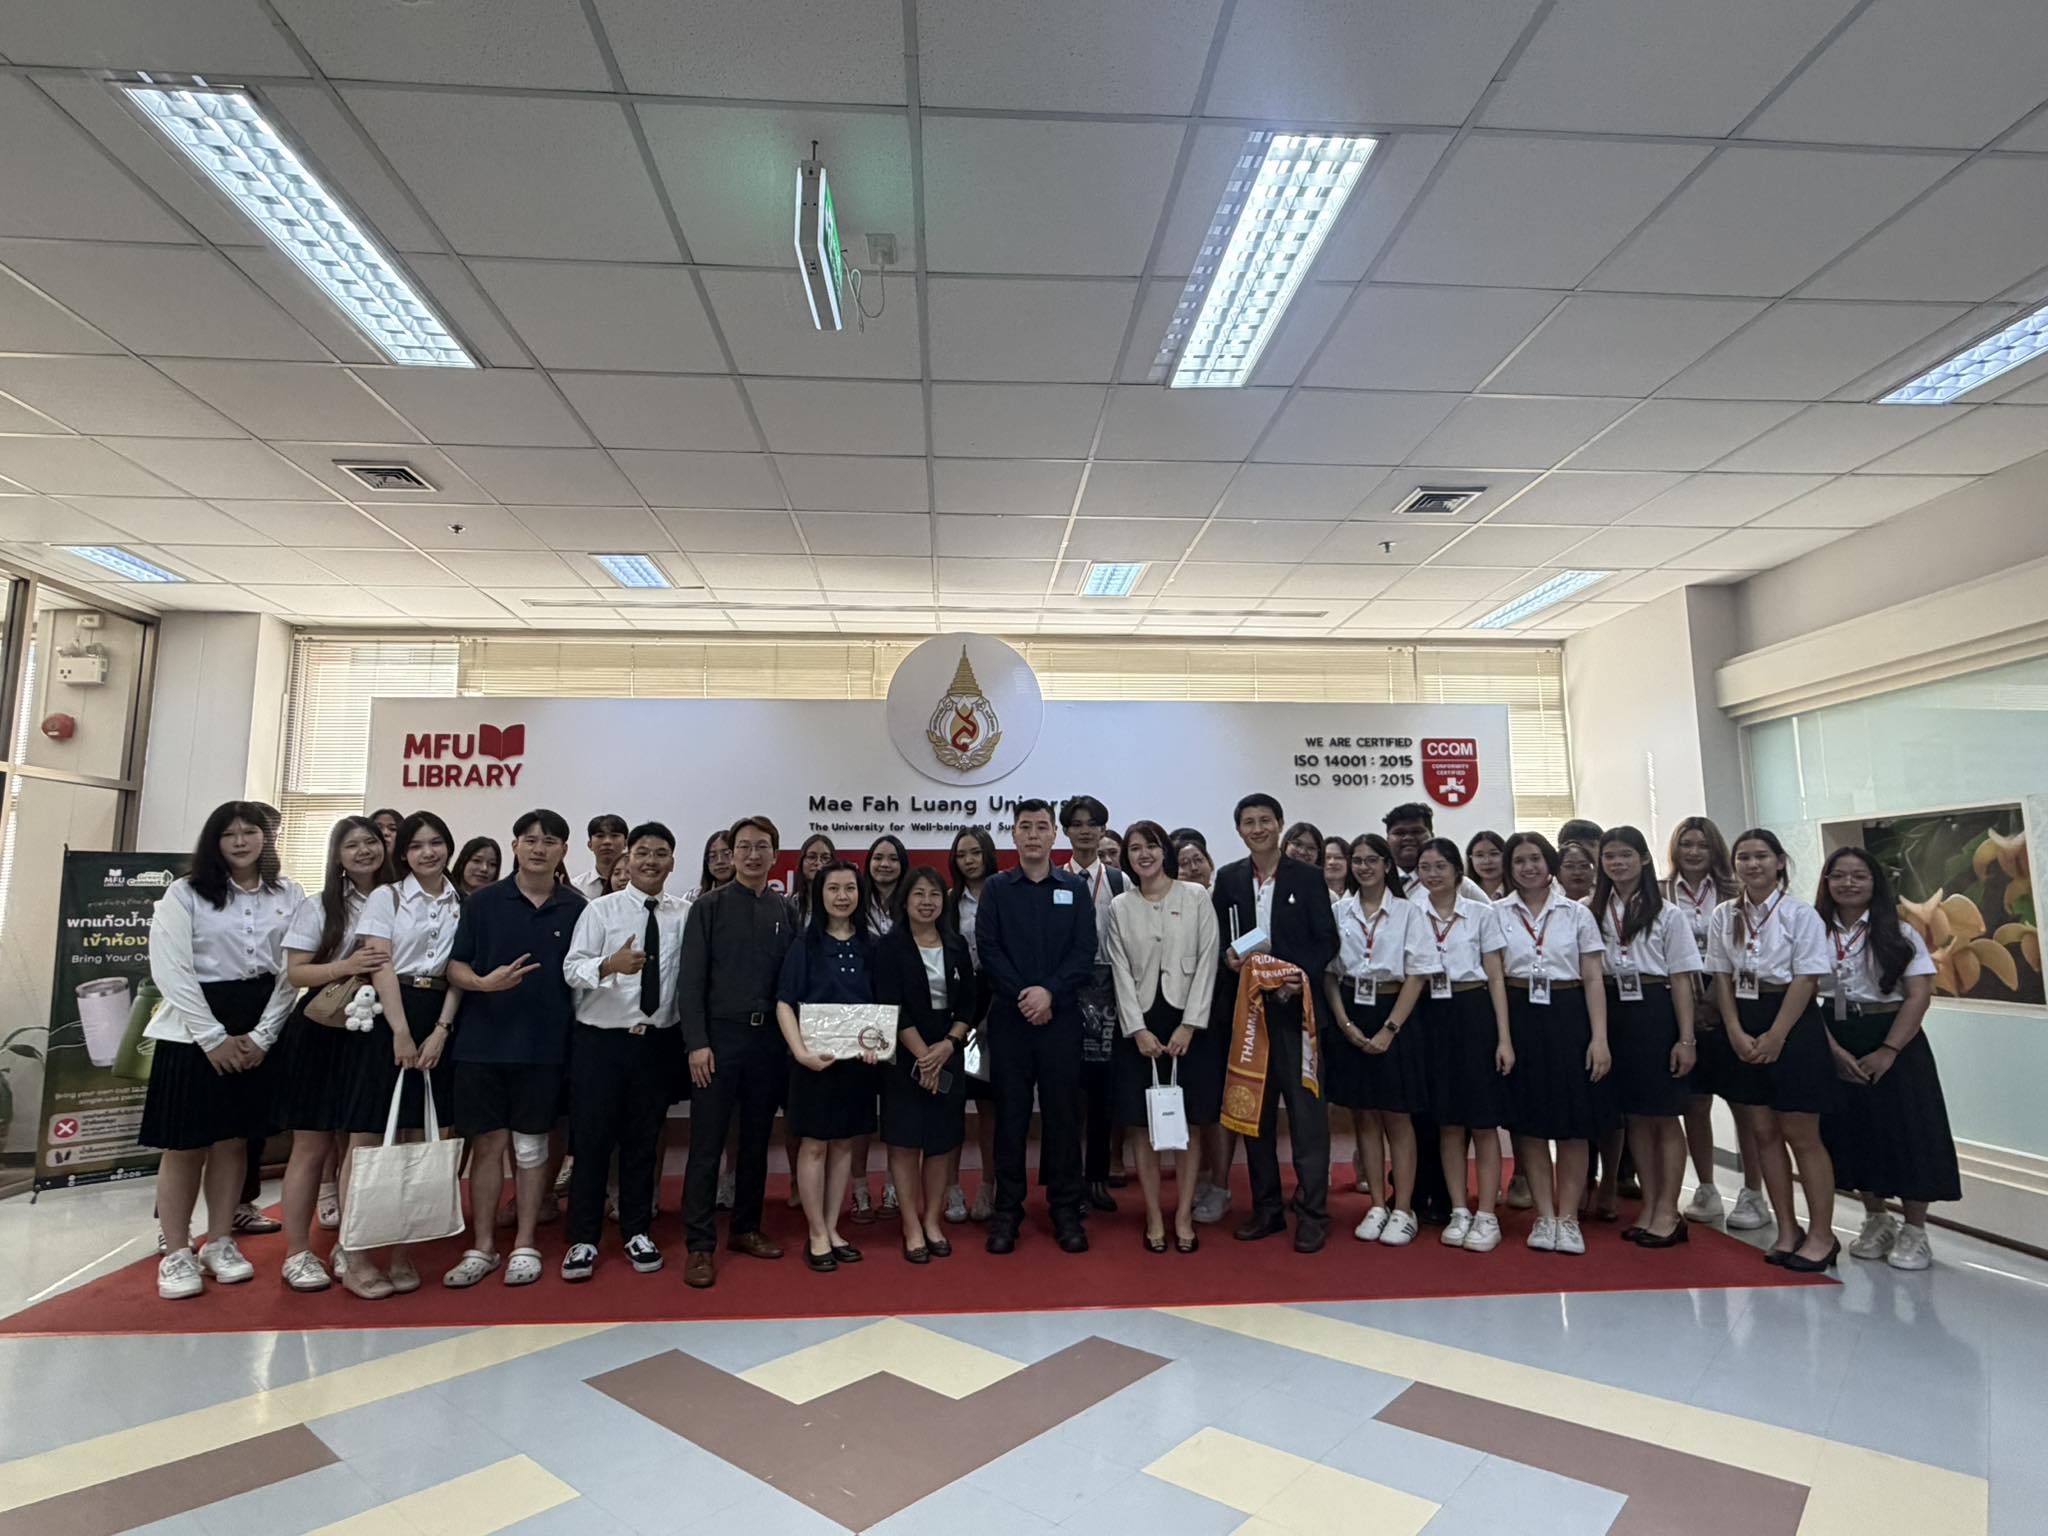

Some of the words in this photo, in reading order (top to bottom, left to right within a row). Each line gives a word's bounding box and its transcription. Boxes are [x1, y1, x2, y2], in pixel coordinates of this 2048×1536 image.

[403, 733, 475, 759] MFU
[1305, 737, 1324, 747] WE
[1329, 737, 1351, 747] ARE
[1356, 737, 1413, 747] CERTIFIED
[1427, 742, 1473, 756] CCQM
[1294, 755, 1319, 767] ISO
[1324, 755, 1367, 767] 14001
[1379, 755, 1413, 767] 2015
[402, 763, 523, 787] LIBRARY
[1295, 774, 1320, 786] ISO
[1332, 774, 1368, 786] 9001
[1380, 774, 1414, 786] 2015
[809, 795, 853, 812] Mae
[862, 795, 899, 812] Fah
[911, 795, 977, 816] Luang
[809, 822, 828, 832] The
[831, 822, 885, 833] University
[890, 822, 905, 832] for
[66, 911, 154, 928] พกแก้วน้ำส
[83, 932, 149, 947] เข้าห้อง
[71, 954, 102, 964] Bring
[105, 953, 131, 962] Your
[134, 952, 151, 961] Ow
[1240, 1003, 1260, 1063] THAMMA
